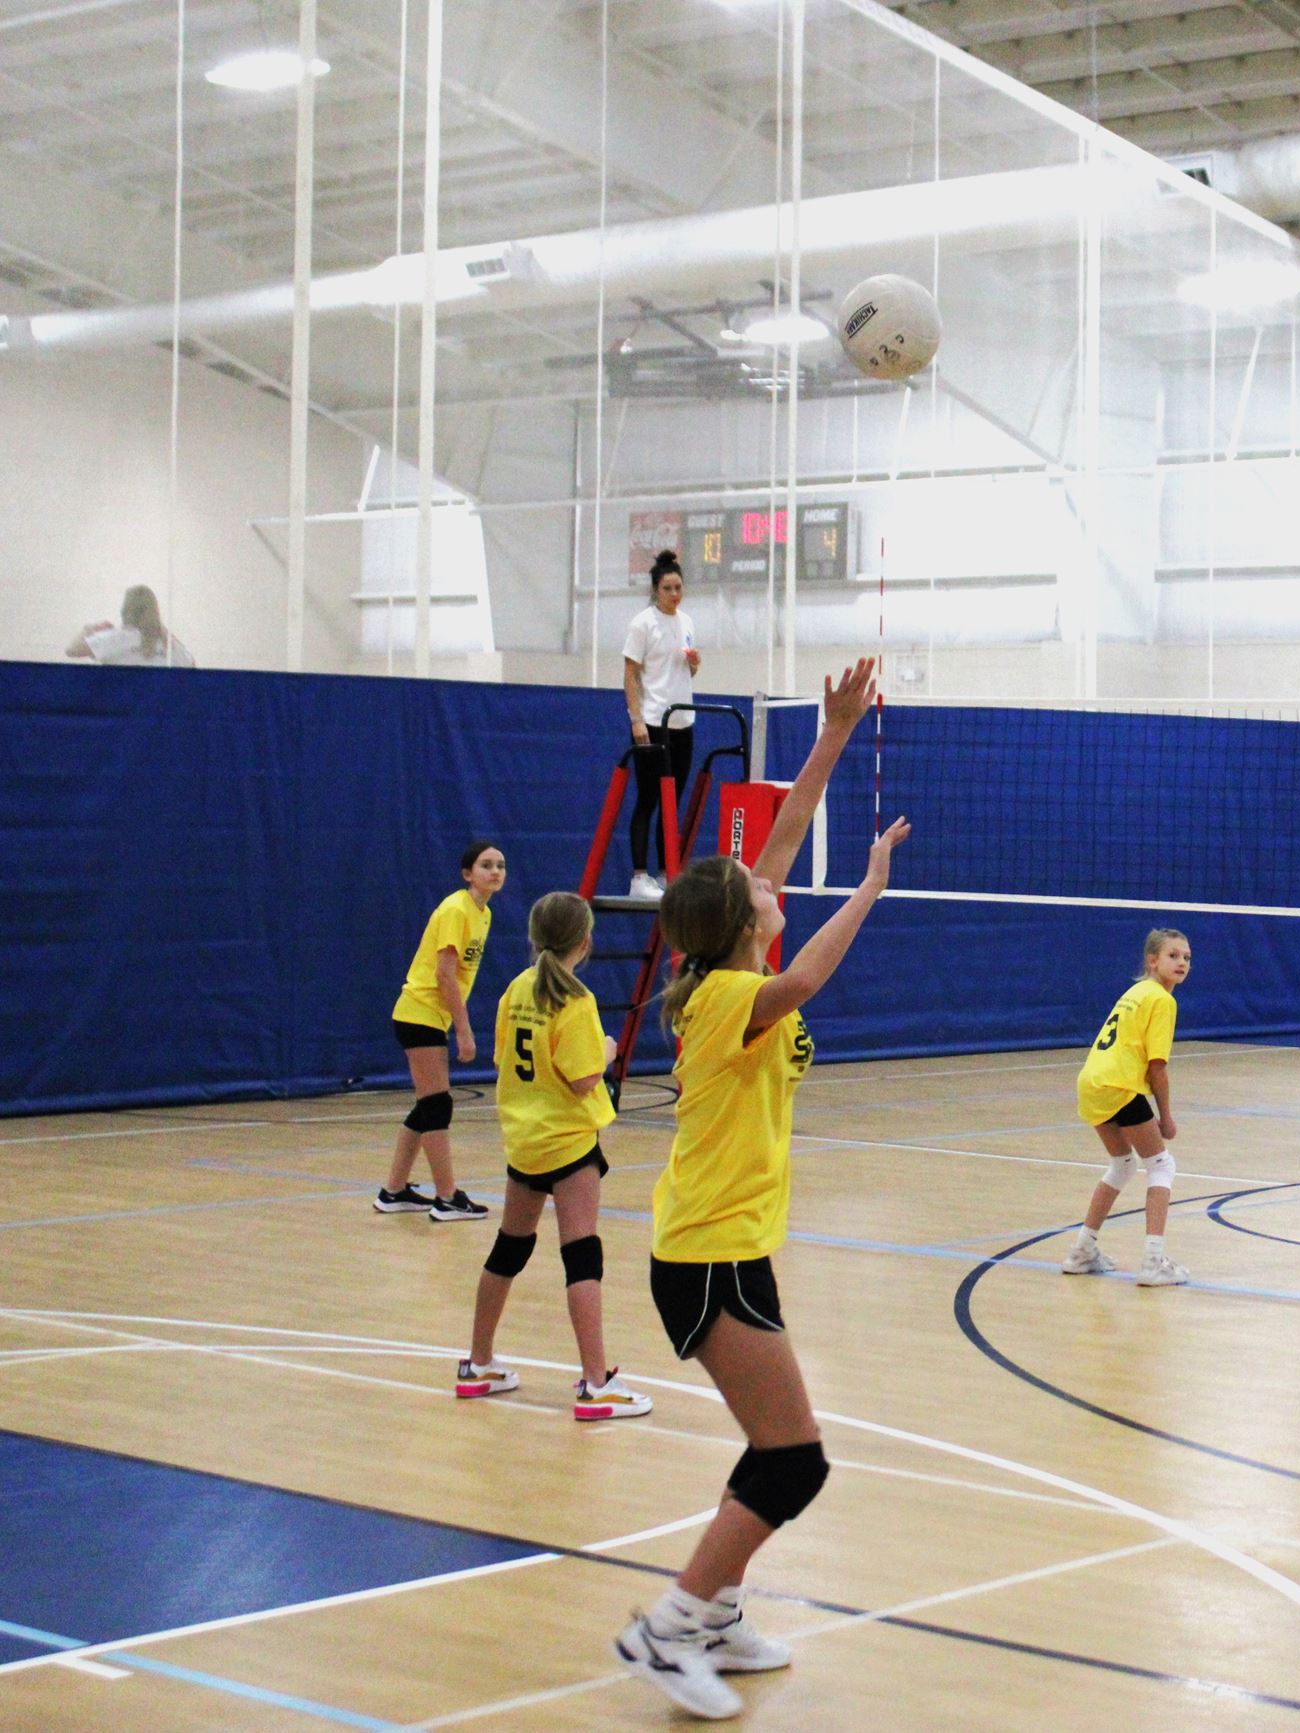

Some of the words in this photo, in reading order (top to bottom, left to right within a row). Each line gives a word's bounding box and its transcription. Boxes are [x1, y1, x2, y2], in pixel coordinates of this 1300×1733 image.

[688, 513, 726, 529] GUEST
[804, 508, 839, 522] HOME
[823, 528, 837, 558] 4
[731, 560, 767, 573] PERIOD
[1096, 1013, 1120, 1051] 3
[514, 1027, 535, 1082] 5
